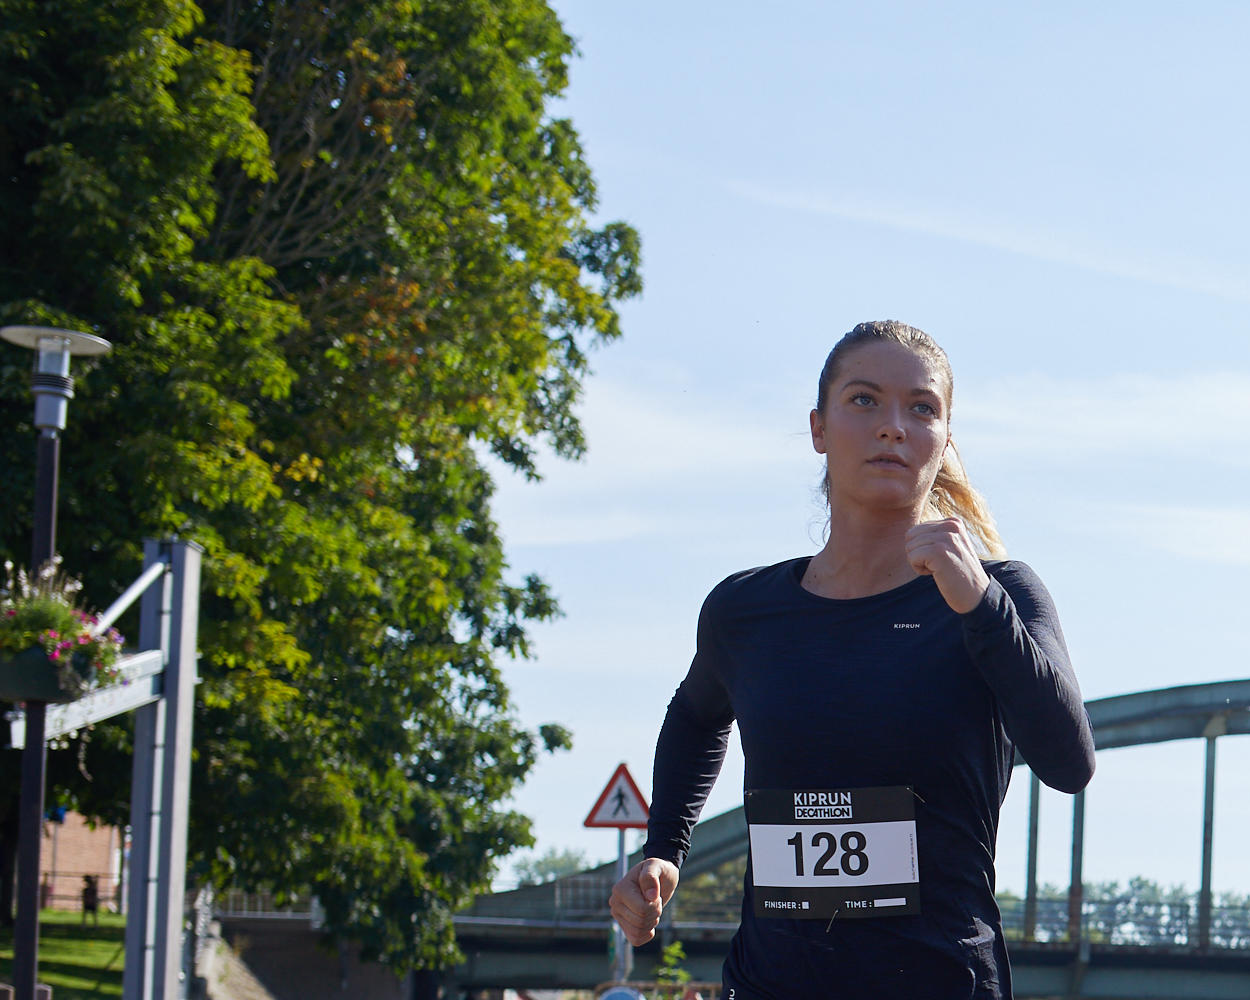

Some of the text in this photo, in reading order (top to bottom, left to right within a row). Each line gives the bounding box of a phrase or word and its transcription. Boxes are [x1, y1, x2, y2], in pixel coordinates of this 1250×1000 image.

[793, 792, 852, 806] KIPRUN
[796, 806, 851, 818] DECATHLON
[787, 831, 869, 877] 128
[845, 900, 867, 908] TIME
